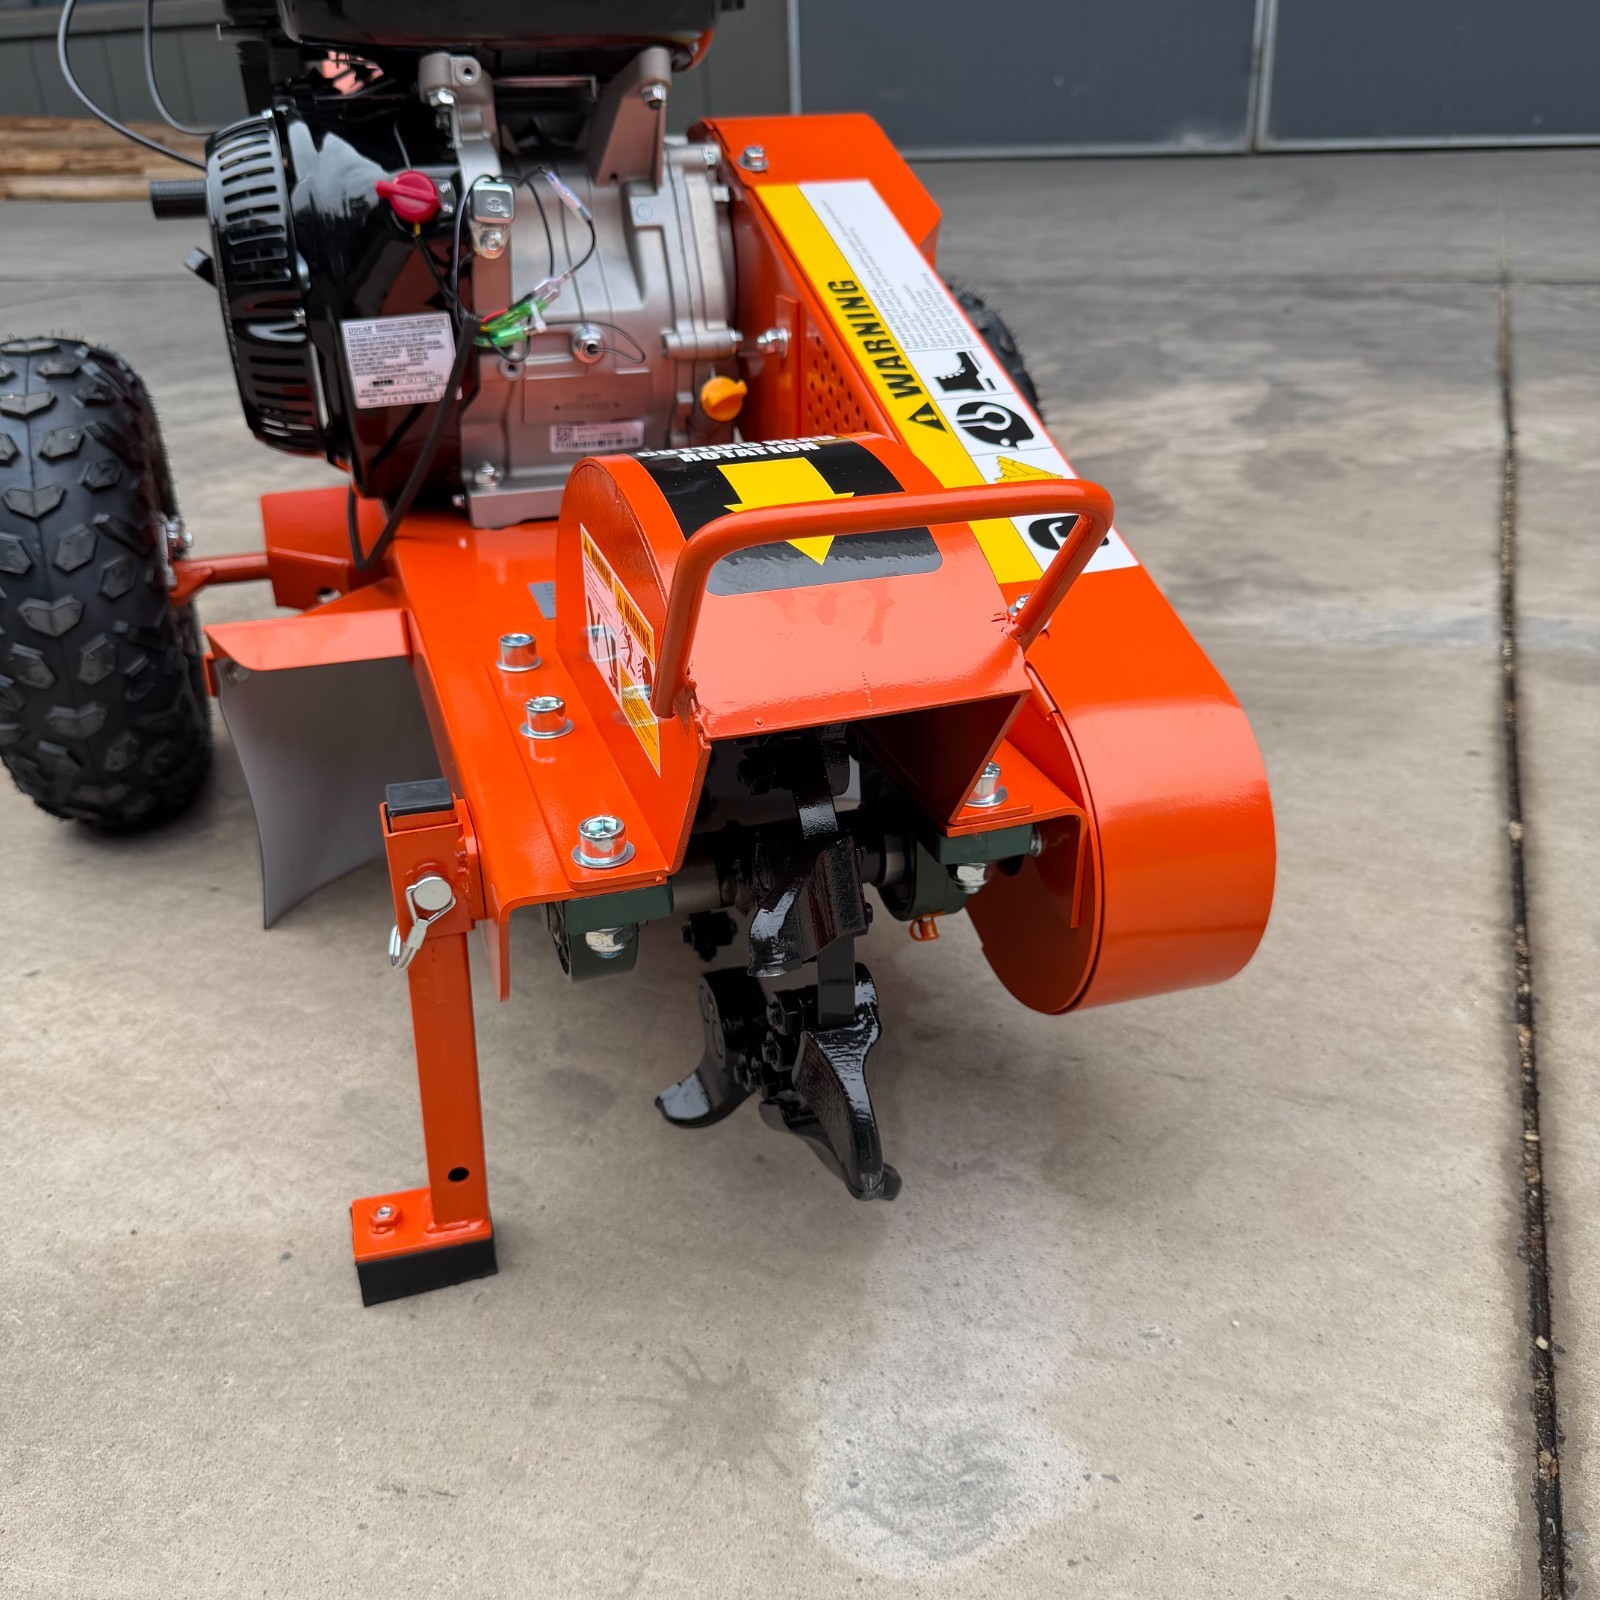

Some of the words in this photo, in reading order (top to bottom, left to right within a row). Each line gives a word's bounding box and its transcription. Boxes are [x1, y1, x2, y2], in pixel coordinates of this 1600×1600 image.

[828, 280, 922, 399] WARNING
[678, 442, 821, 462] ROTATION
[623, 596, 651, 656] WARNING
